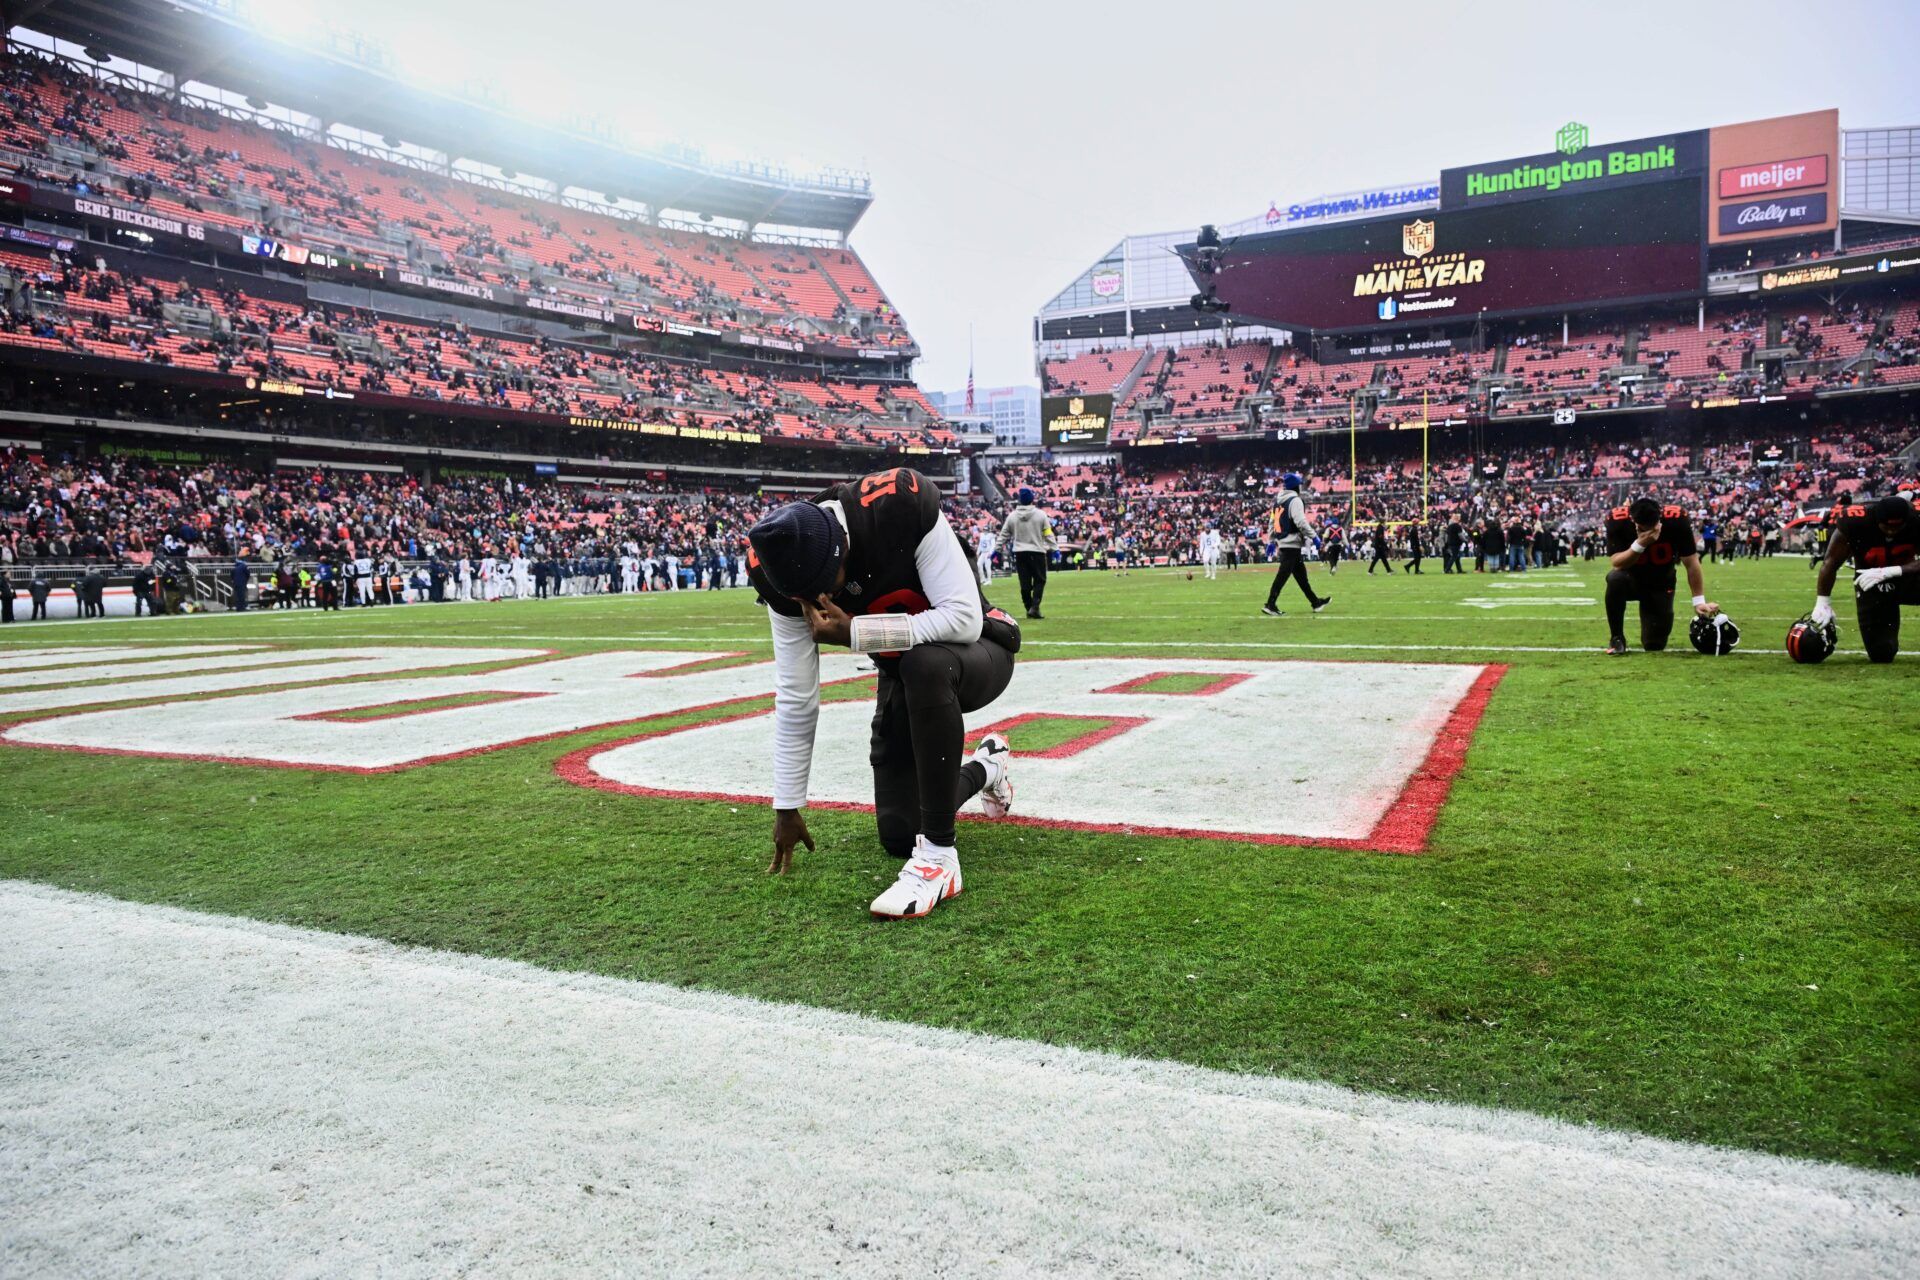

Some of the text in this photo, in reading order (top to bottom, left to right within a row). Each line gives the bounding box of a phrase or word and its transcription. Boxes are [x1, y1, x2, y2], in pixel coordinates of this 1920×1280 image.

[1466, 144, 1676, 191] Huntington Bank
[1740, 164, 1806, 188] meijer
[75, 199, 205, 241] GENE HICKERSON 66
[1737, 203, 1807, 225] Bally BET
[1408, 236, 1430, 251] NFL
[1373, 252, 1466, 271] WALTER PAYTON
[1406, 267, 1422, 279] OF
[399, 271, 424, 286] MIKE
[481, 287, 495, 300] 74
[1353, 269, 1406, 297] MAN
[1405, 277, 1424, 290] THE
[1423, 259, 1486, 289] YEAR
[1349, 347, 1367, 355] TEXT
[1369, 345, 1392, 354] ISSUES
